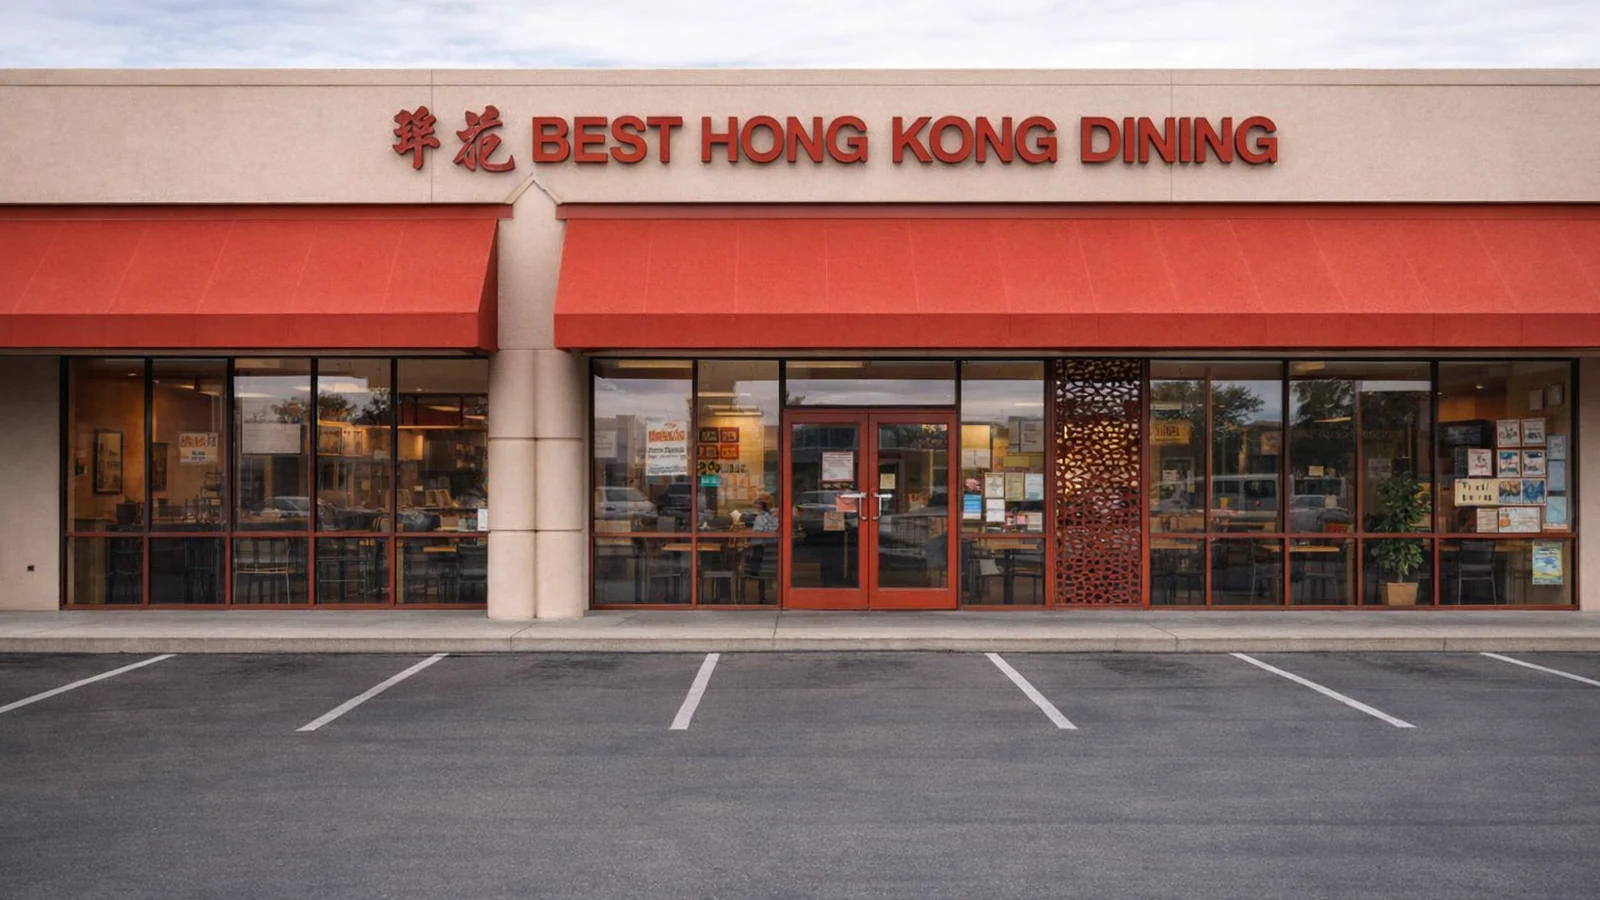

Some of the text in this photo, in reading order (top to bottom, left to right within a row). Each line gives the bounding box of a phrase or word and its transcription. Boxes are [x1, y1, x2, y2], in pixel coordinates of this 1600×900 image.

[532, 115, 1279, 164] BEST HONG KONG DINING
